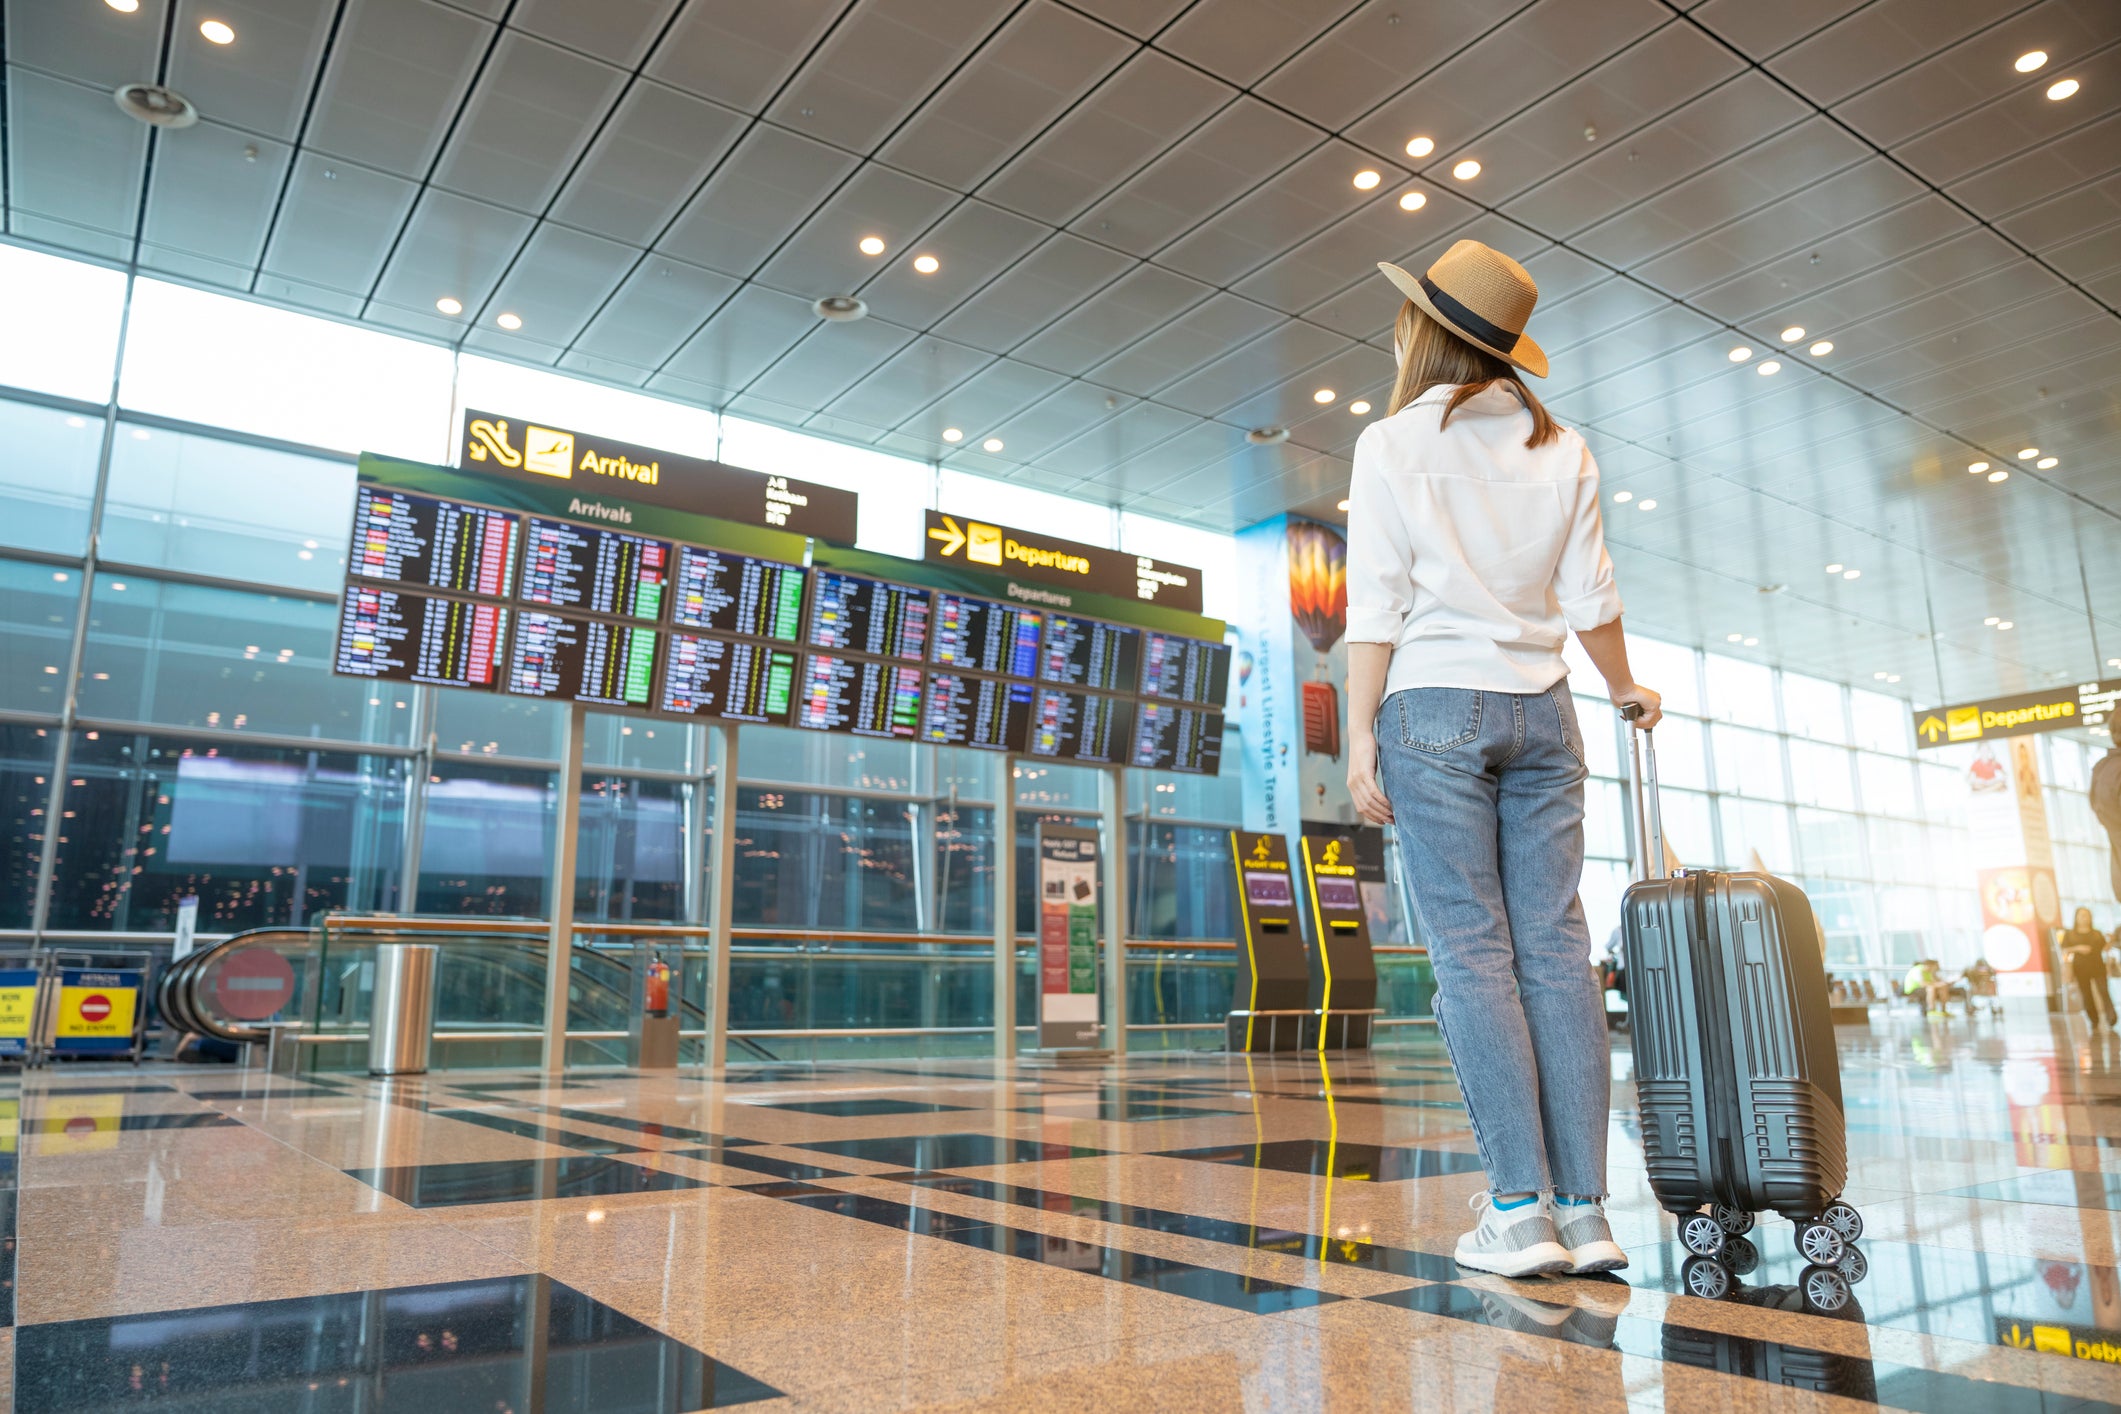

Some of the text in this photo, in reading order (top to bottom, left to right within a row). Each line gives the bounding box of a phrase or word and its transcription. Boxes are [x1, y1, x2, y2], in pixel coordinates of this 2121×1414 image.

[579, 449, 659, 485] Arrival
[568, 498, 632, 524] Arrivals
[1005, 539, 1090, 574] Departure
[1007, 582, 1072, 607] Departures
[1258, 628, 1271, 691] Largest
[1982, 701, 2075, 729] Departure
[1262, 696, 1275, 771] Lifestyle
[1264, 776, 1278, 828] Travel
[69, 1023, 117, 1032] NO ENTRY
